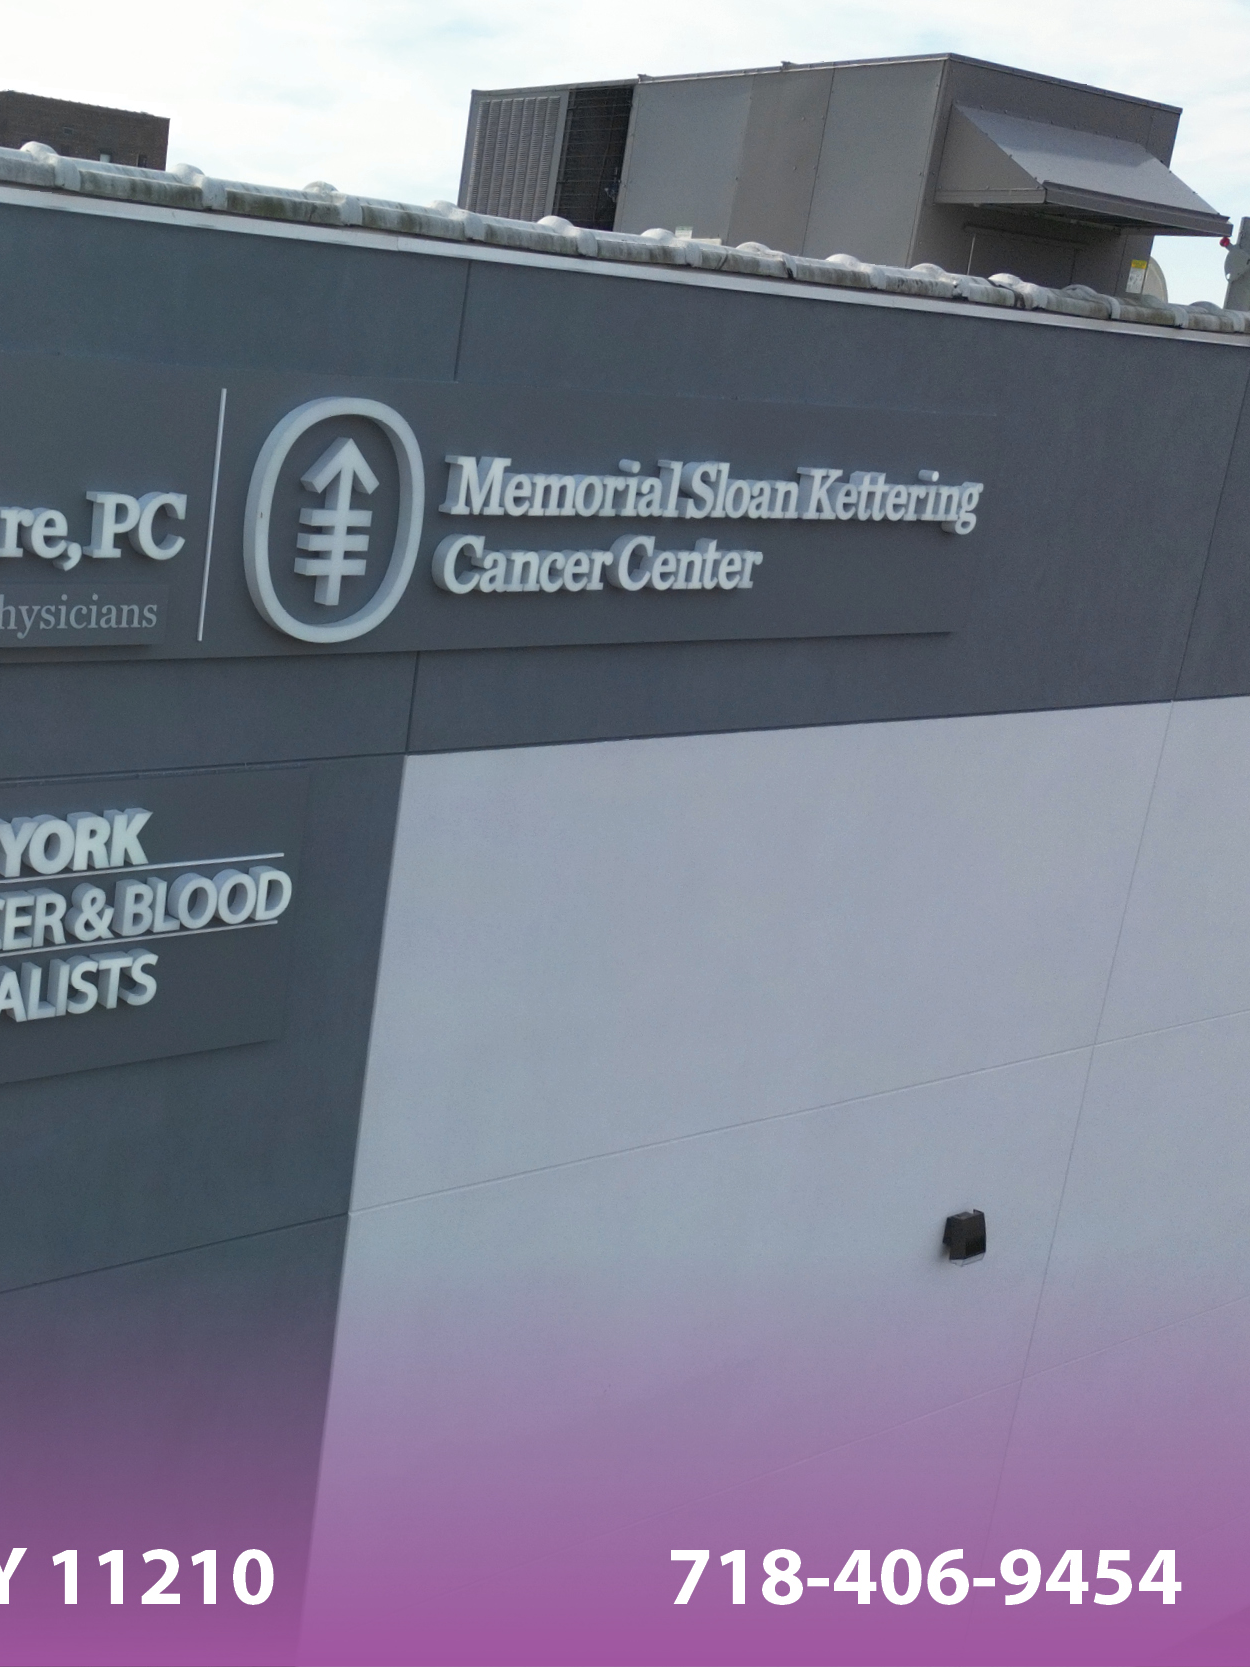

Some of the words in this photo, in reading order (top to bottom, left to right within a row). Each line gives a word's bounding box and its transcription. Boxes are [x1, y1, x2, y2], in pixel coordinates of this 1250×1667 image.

[83, 491, 188, 561] PC
[438, 455, 682, 518] Memorial
[680, 460, 797, 520] Sloan
[796, 466, 983, 535] Kettering
[432, 534, 613, 594] Cancer
[608, 533, 762, 592] Center
[65, 883, 115, 941] &
[112, 866, 293, 937] BLOOD
